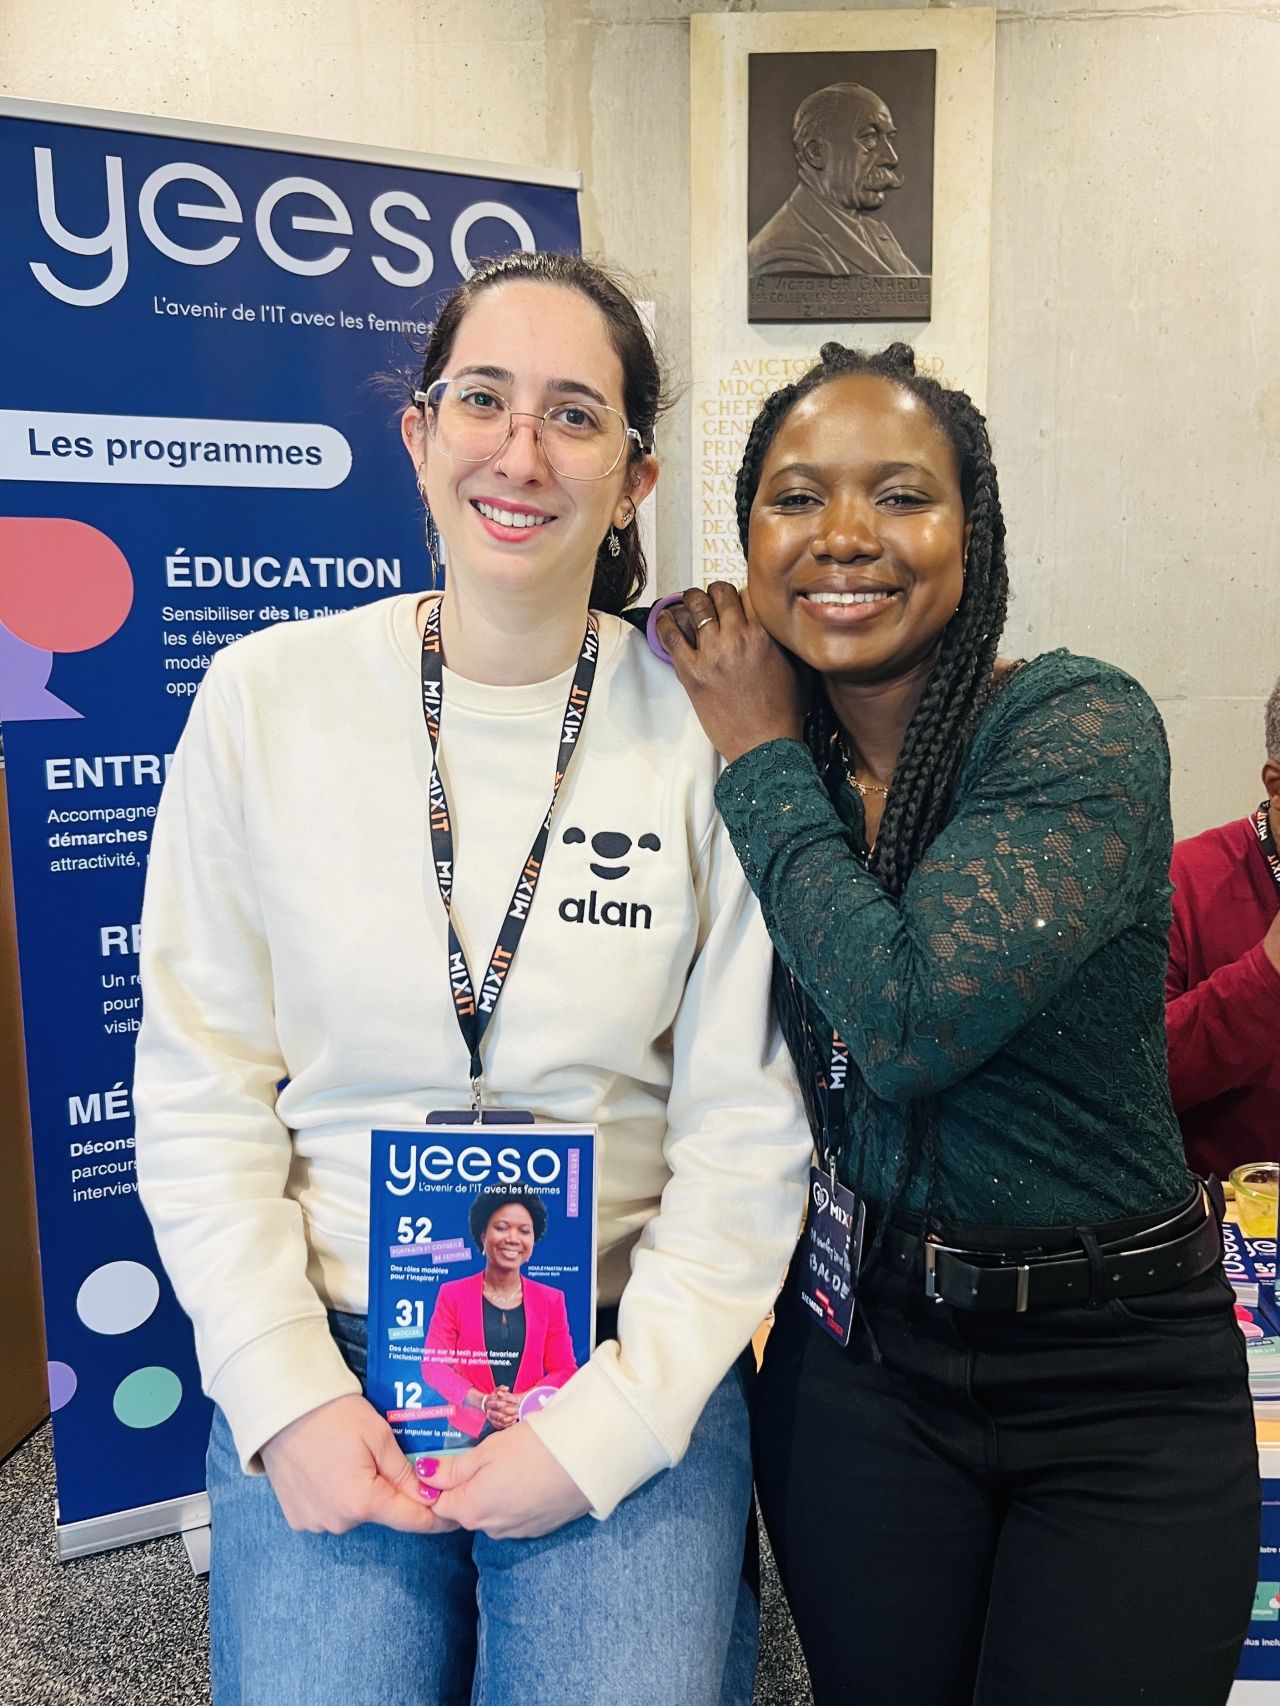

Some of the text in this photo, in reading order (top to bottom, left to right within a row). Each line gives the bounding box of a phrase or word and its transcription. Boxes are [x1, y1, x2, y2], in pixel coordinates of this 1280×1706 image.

[29, 146, 537, 307] yeeso
[232, 304, 255, 321] de
[290, 312, 336, 327] avec
[340, 311, 363, 330] les
[28, 428, 323, 469] Les programmes
[165, 547, 401, 589] ÉDUCATION
[162, 606, 255, 622] Sensibiliser
[259, 606, 290, 621] dès
[294, 606, 309, 620] le
[163, 631, 187, 646] les
[562, 684, 588, 743] MIXIT
[429, 769, 449, 832] MIXIT
[48, 829, 148, 848] démarches
[50, 852, 141, 873] attractivité,
[509, 855, 541, 920] MIXIT
[558, 890, 652, 929] alan
[102, 973, 125, 989] Un
[450, 951, 475, 1016] MIXIT
[479, 945, 513, 1014] MIXIT
[103, 997, 141, 1015] pour
[68, 1081, 131, 1126] MÉ
[70, 1137, 136, 1158] Décons
[386, 1143, 561, 1196] yeeso
[455, 1183, 468, 1194] de
[483, 1185, 507, 1195] avec
[509, 1184, 522, 1194] les
[523, 1184, 561, 1195] femmes
[397, 1216, 433, 1244] 52
[390, 1264, 449, 1275] Des rôles modèles
[390, 1273, 405, 1281] pour
[396, 1298, 425, 1328] 31
[389, 1344, 402, 1352] Des
[489, 1350, 520, 1358] favoriser
[394, 1381, 423, 1409] 12
[404, 1428, 433, 1437] impulser
